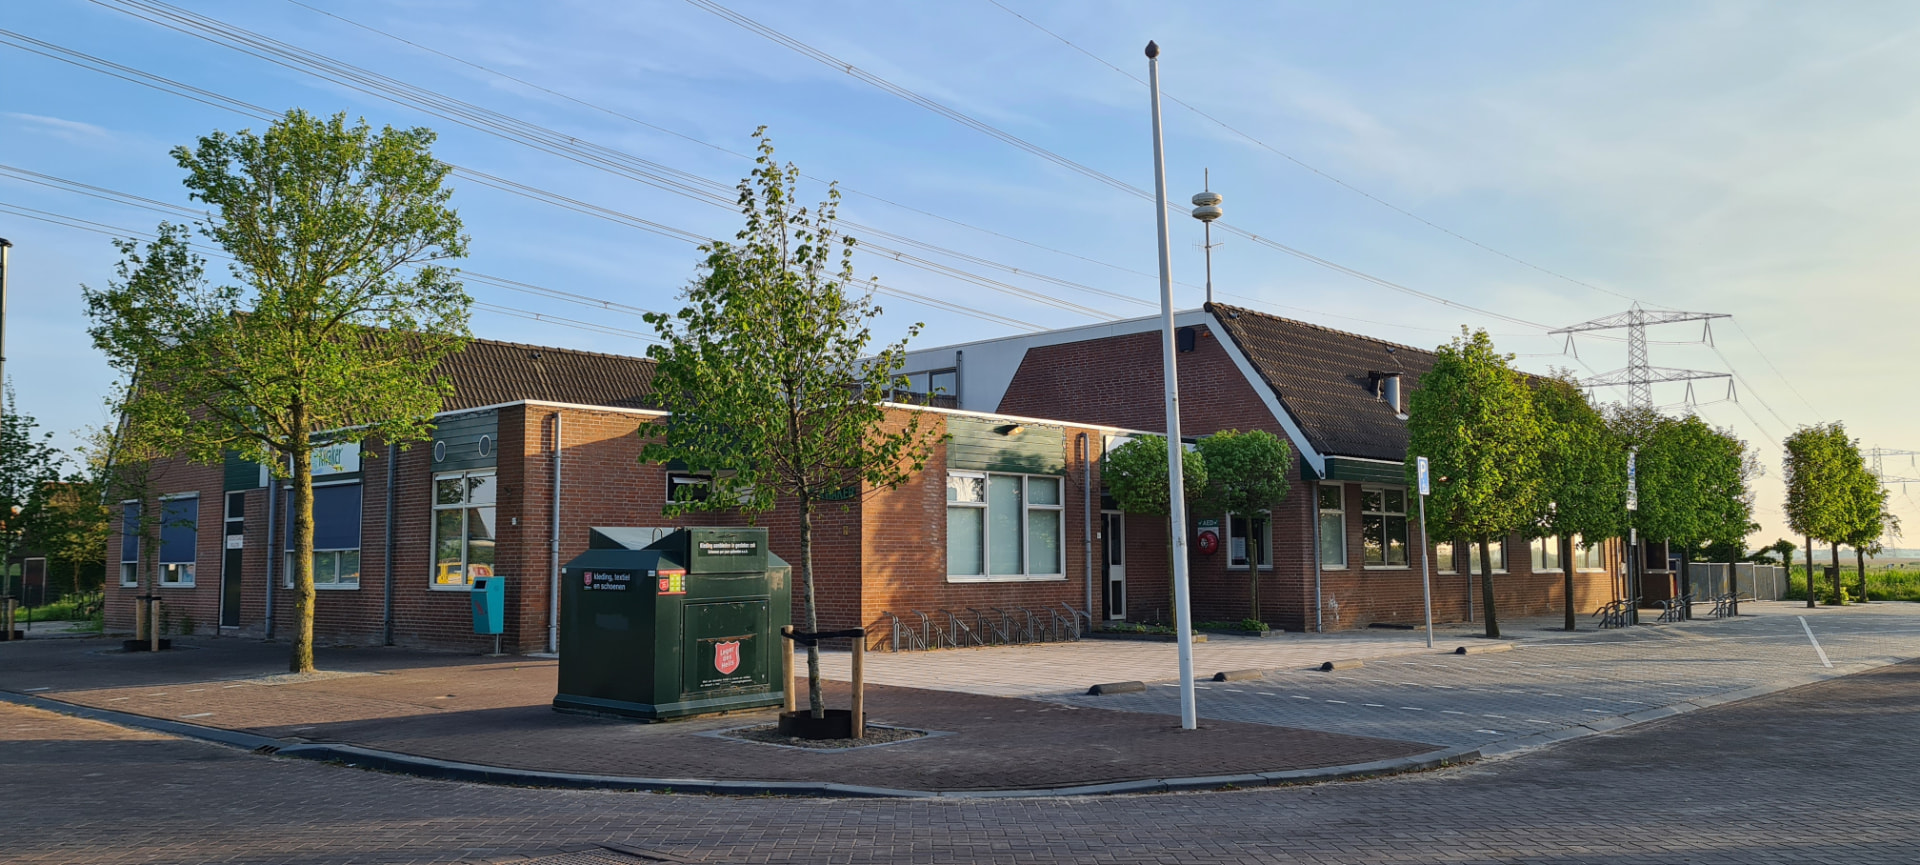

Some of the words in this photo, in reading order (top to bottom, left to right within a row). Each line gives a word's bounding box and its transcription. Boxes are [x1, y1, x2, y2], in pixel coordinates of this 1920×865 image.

[1420, 461, 1426, 479] P
[601, 582, 626, 590] schoenen
[720, 647, 734, 656] Leger
[722, 660, 734, 668] Heils
